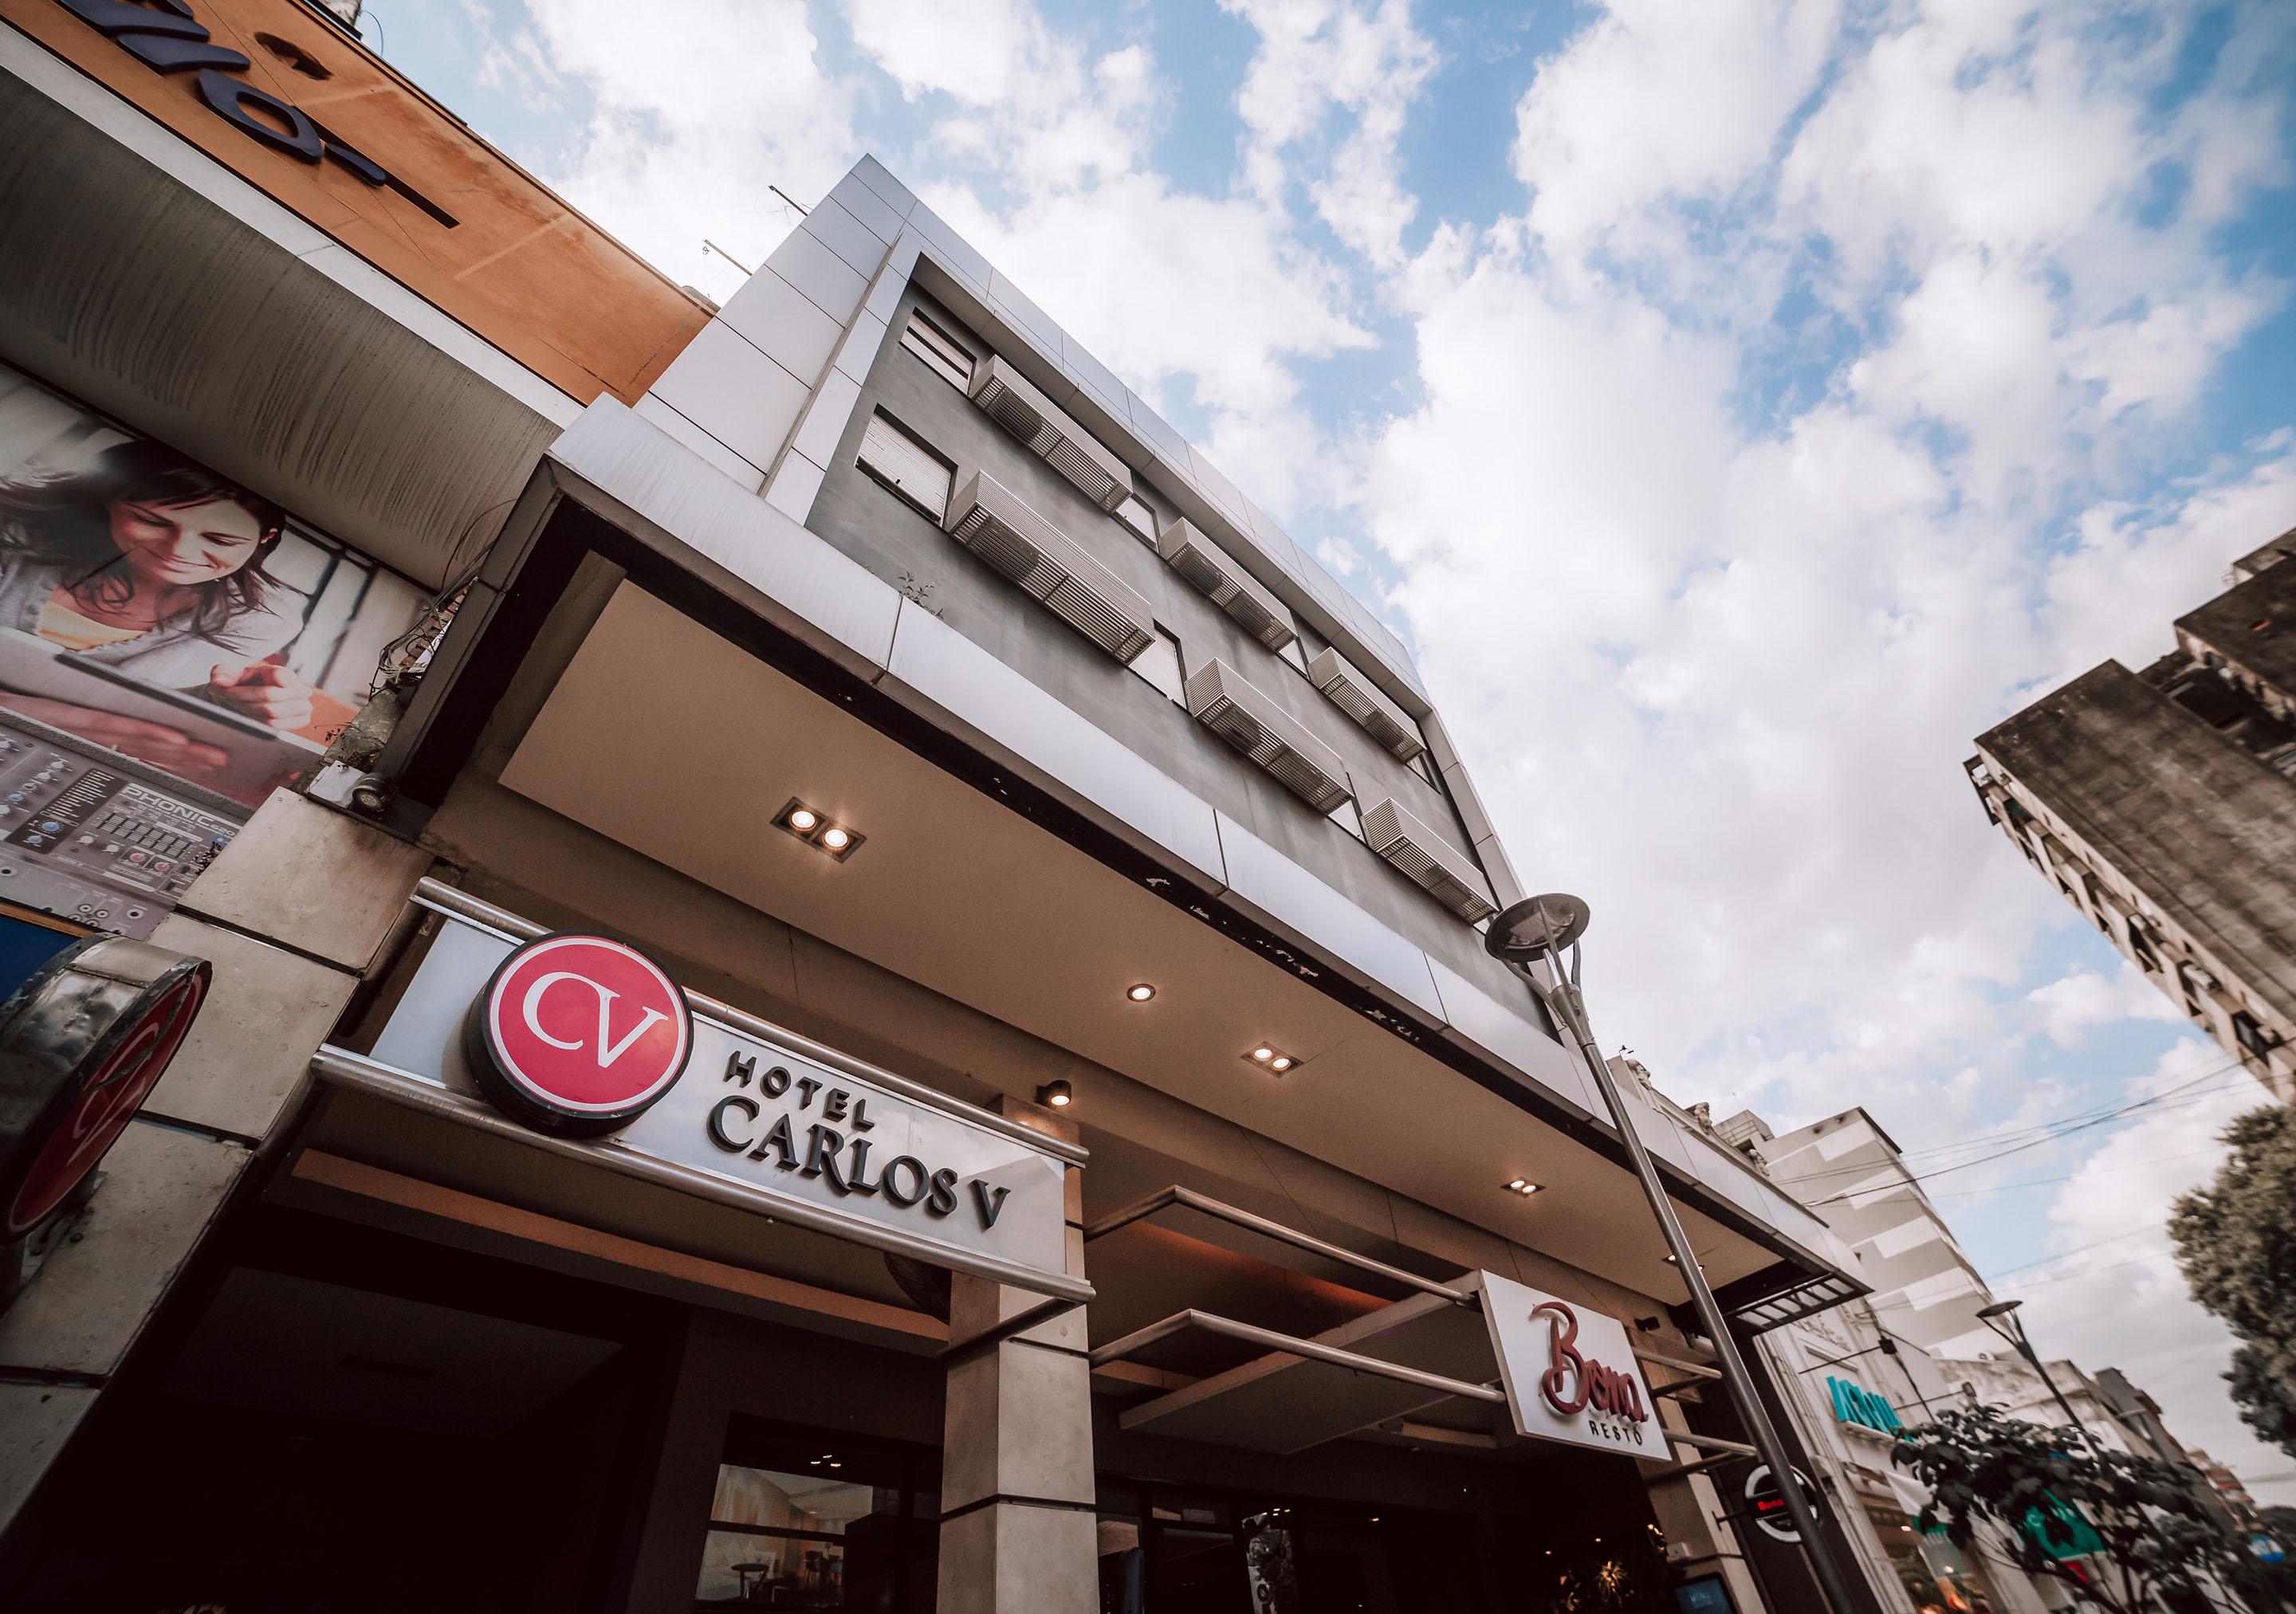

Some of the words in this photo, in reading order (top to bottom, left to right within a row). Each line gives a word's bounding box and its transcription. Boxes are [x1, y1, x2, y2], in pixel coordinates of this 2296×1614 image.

[120, 786, 214, 827] PHONIC
[522, 972, 669, 1068] CV
[722, 1050, 875, 1132] HOTEL
[706, 1094, 958, 1216] CARLOS
[969, 1179, 1012, 1230] V
[1530, 1302, 1649, 1423] Bona
